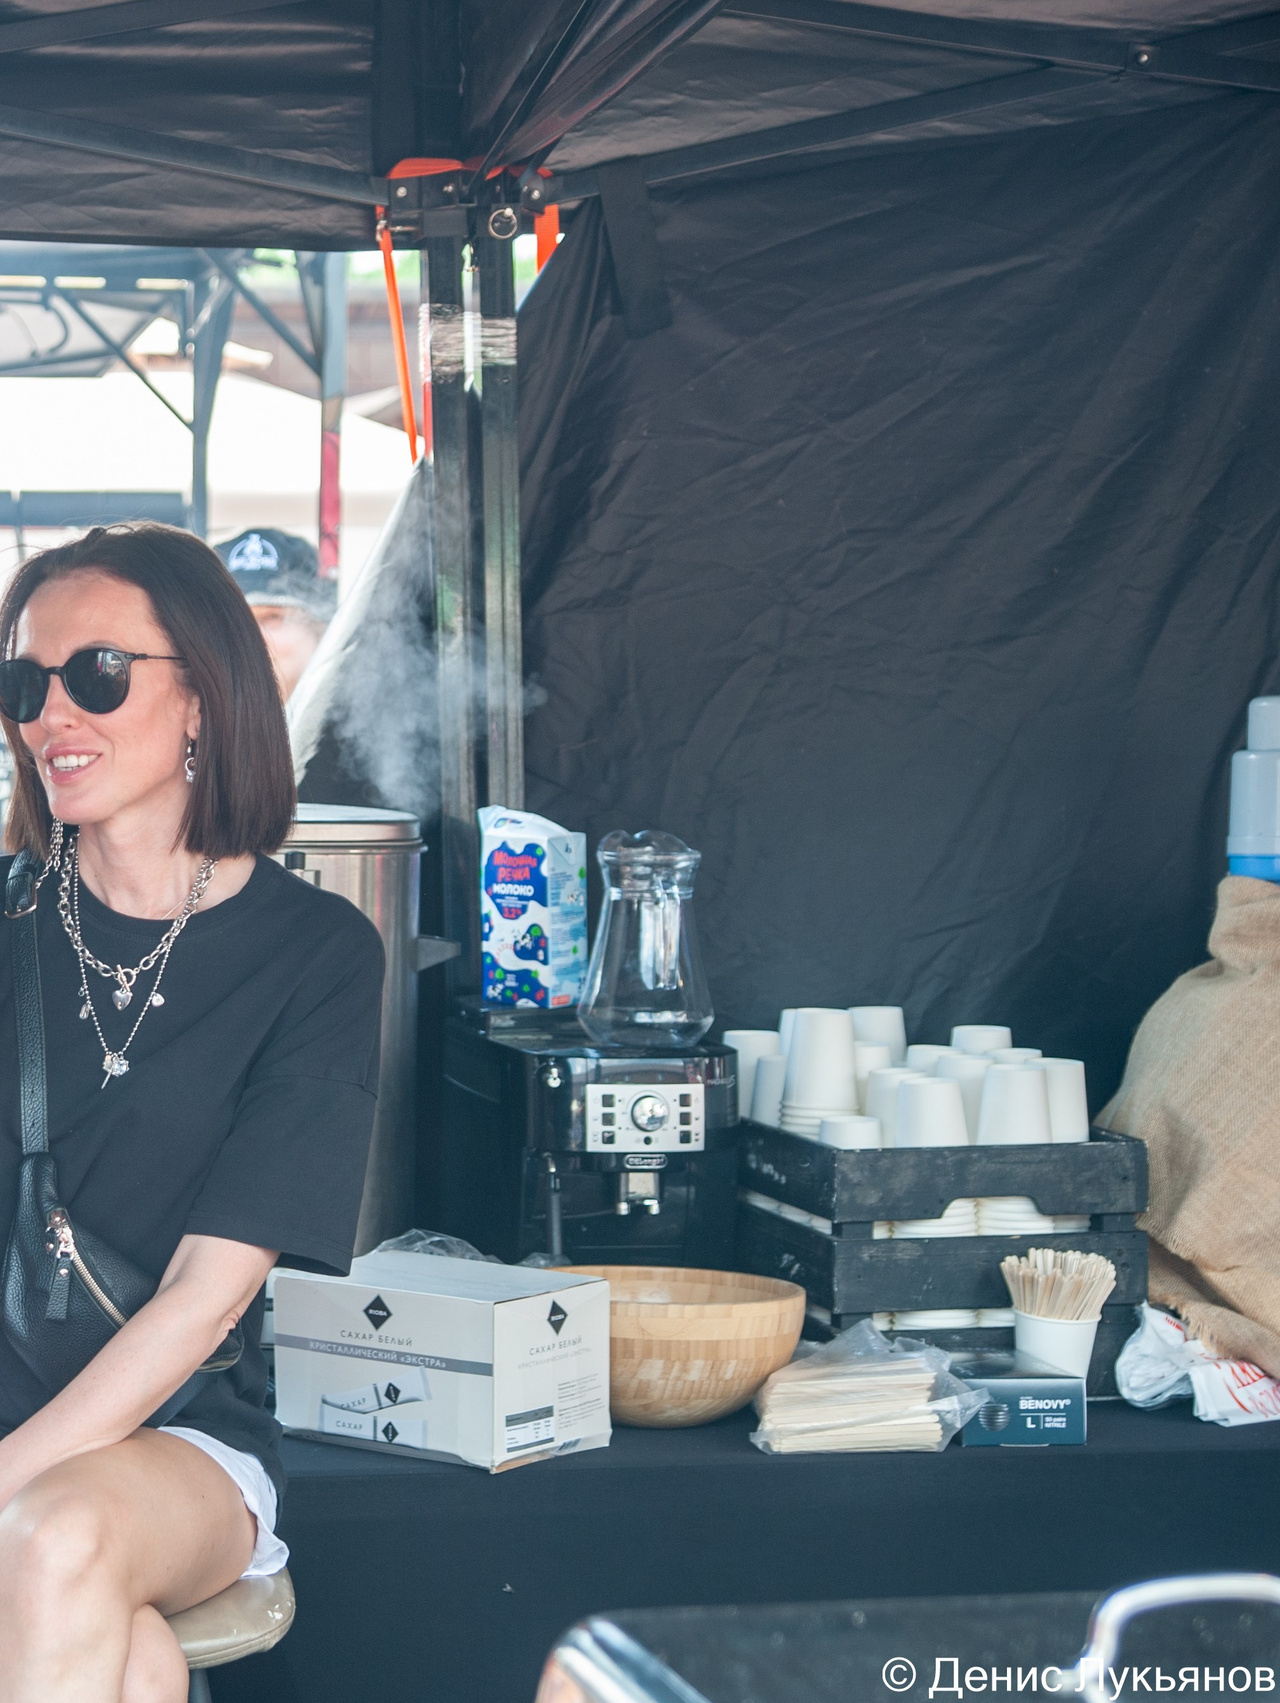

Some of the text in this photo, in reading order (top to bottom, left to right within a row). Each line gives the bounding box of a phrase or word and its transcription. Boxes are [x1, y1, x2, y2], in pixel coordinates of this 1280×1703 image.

[497, 866, 531, 883] РЕЧКА
[492, 882, 535, 897] МОЛОКО
[368, 1308, 388, 1317] RIOBA
[340, 1330, 413, 1347] САХАР БЕЛЫЙ
[529, 1335, 582, 1356] САХАР БЕЛЫЙ
[309, 1340, 447, 1369] КРИСТАЛЛИЧЕСКИЙ «ЭКСТРА»
[335, 1420, 363, 1432] САХАР
[1026, 1416, 1036, 1428] L
